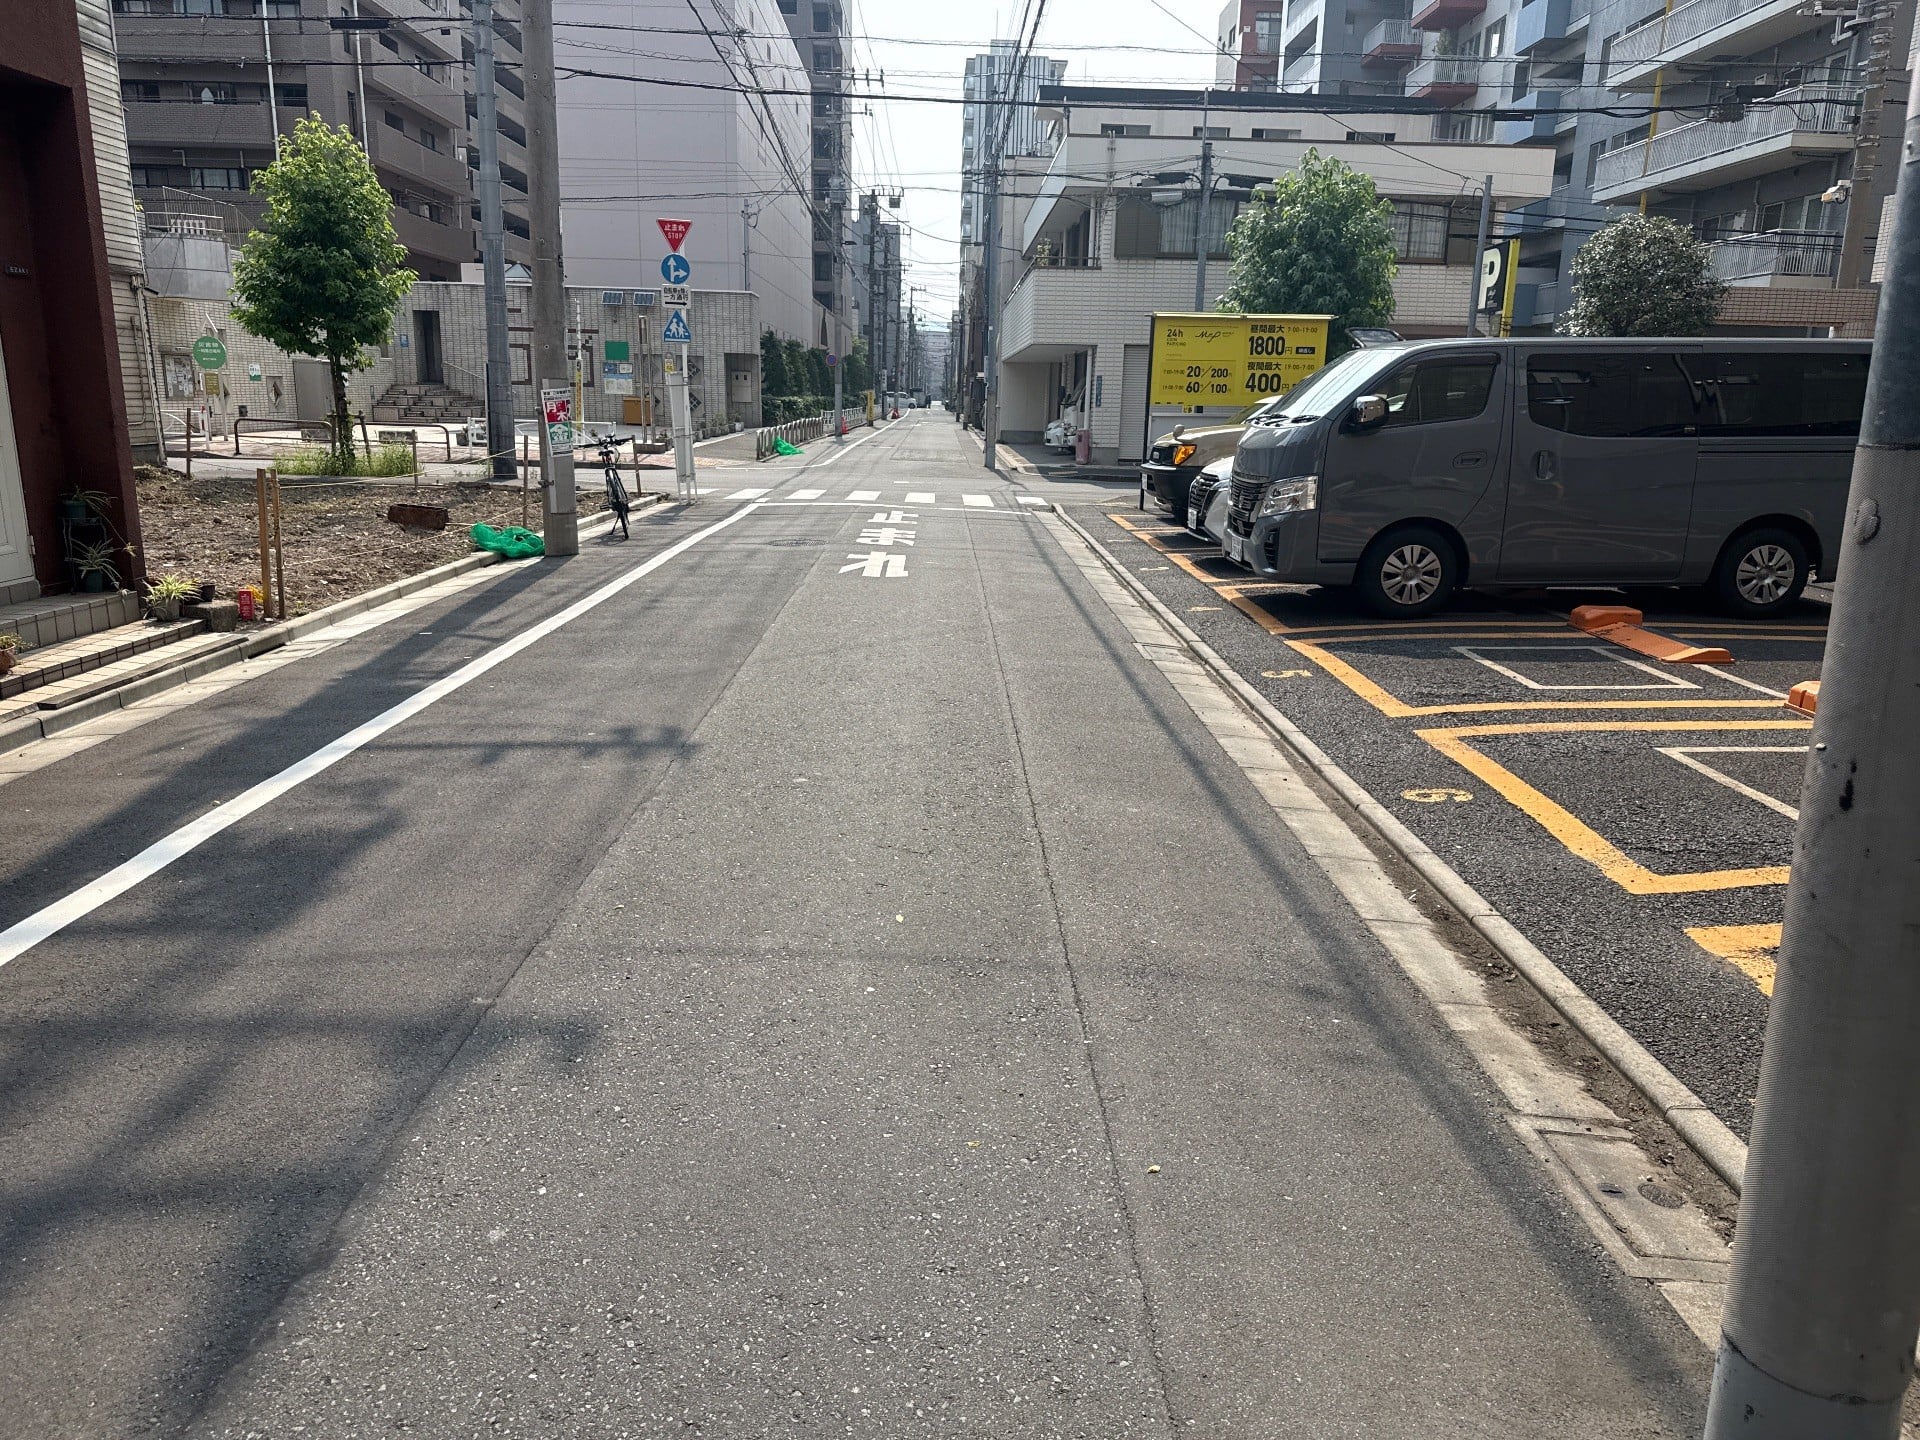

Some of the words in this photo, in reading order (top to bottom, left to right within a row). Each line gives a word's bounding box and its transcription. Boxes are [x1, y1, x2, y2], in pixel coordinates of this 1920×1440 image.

[1477, 248, 1501, 310] P
[1167, 328, 1184, 338] 24h
[547, 402, 556, 413] 月
